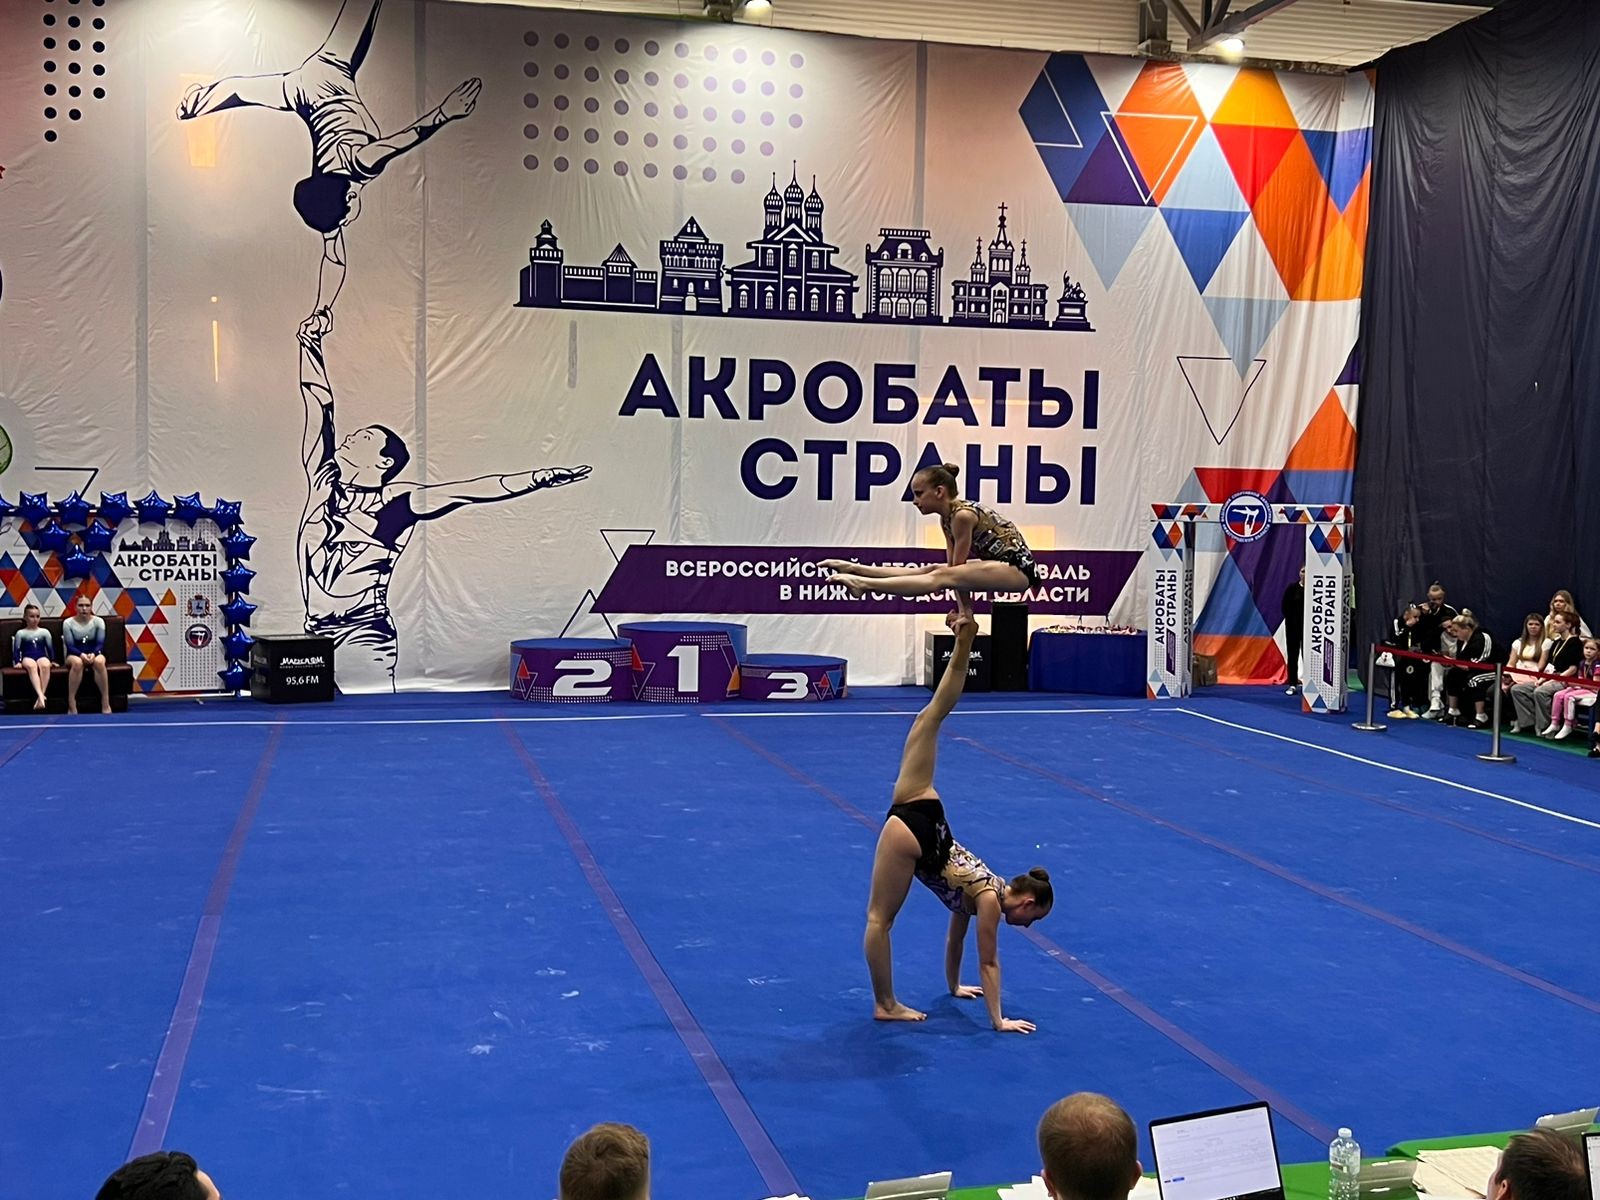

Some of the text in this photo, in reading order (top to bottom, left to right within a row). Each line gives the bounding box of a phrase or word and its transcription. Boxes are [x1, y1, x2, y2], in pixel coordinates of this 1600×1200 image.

[618, 352, 1100, 430] АКРОБАТЫ
[113, 553, 217, 567] АКРОБАТЫ
[138, 568, 217, 581] СТРАНЫ
[780, 585, 792, 600] В
[1155, 569, 1165, 645] АКРОБАТЫ
[1166, 570, 1177, 627] СТРАНЫ
[1324, 575, 1336, 636] СТРАНЫ
[1311, 575, 1323, 654] АКРОБАТЫ
[305, 675, 319, 684] FM
[552, 660, 612, 696] 2
[666, 645, 699, 692] 1
[767, 672, 809, 700] 3
